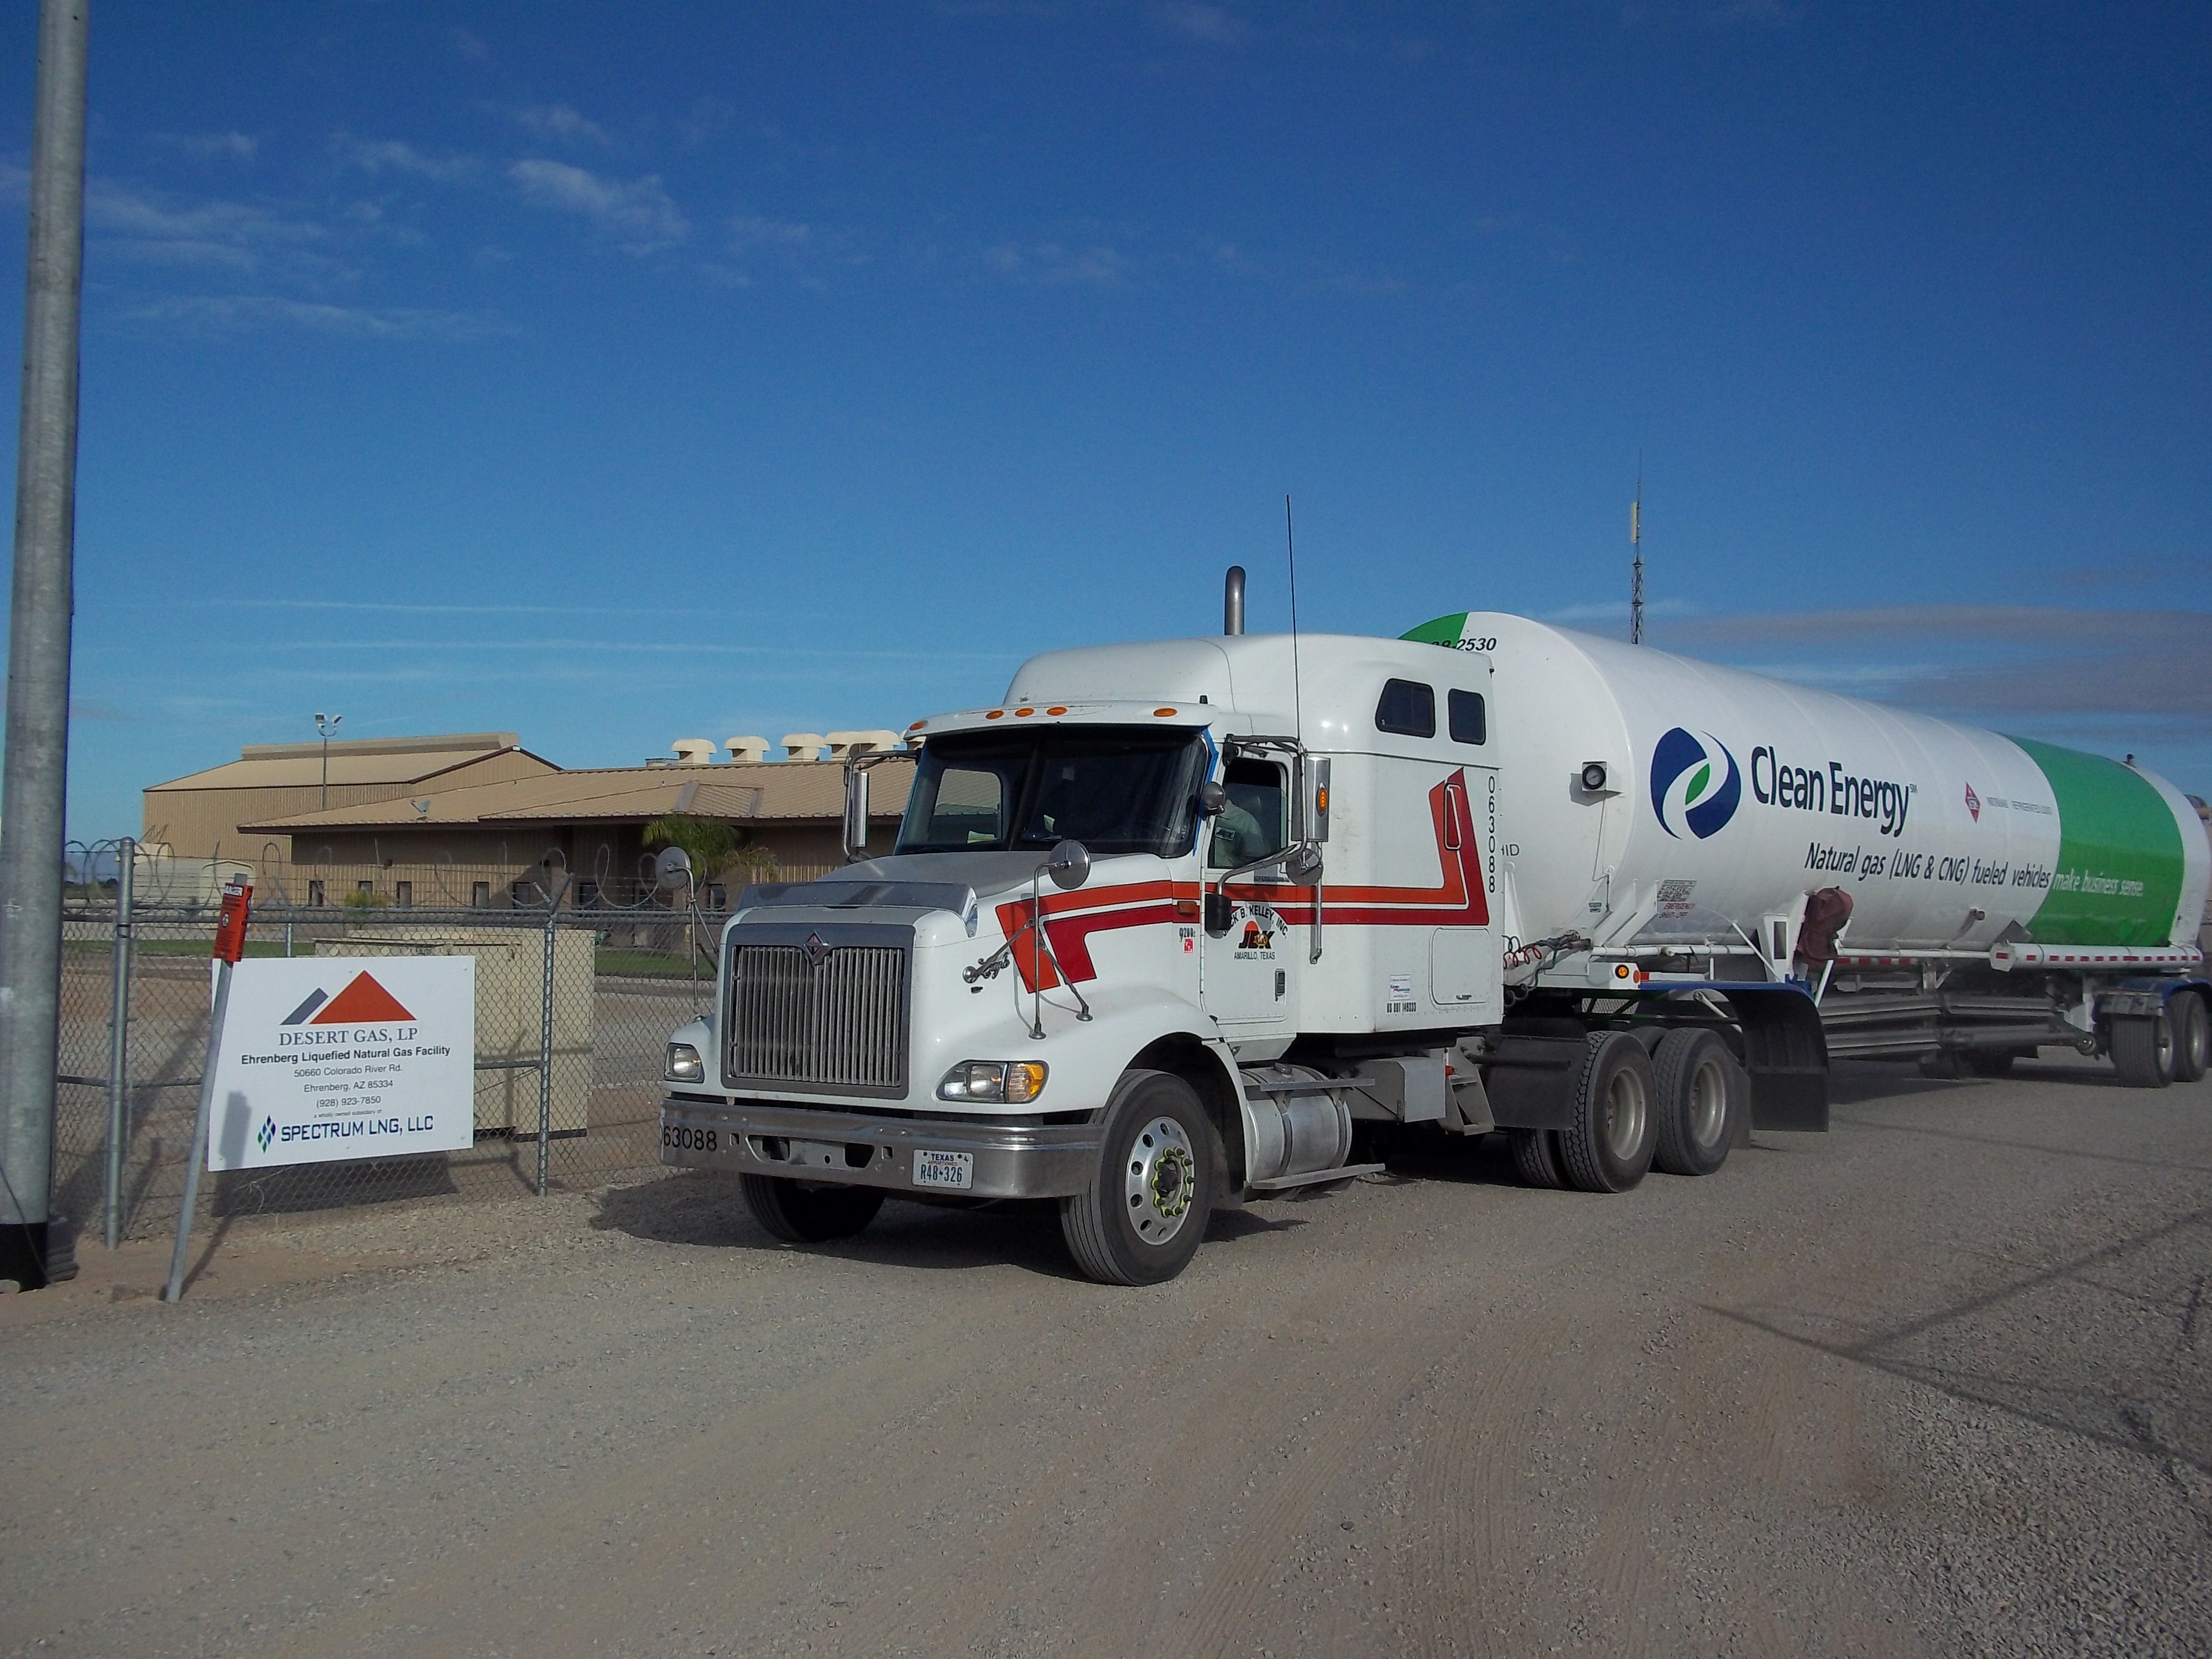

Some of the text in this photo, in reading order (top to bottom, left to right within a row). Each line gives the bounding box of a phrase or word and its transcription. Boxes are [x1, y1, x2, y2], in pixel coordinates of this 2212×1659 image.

[1751, 745, 1909, 838] Clean Energy
[1804, 842, 1861, 873] Natural
[1858, 854, 1886, 881] gas
[1889, 848, 1922, 880] (LNG
[1923, 855, 1934, 880] &
[1938, 855, 1970, 885] CNG)
[1971, 858, 2009, 885] fueled
[2011, 863, 2052, 888] vehicles
[2052, 868, 2081, 891] make
[1240, 907, 1248, 919] B.
[1249, 904, 1274, 925] KELLEY,
[1276, 917, 1288, 940] INC.
[1234, 951, 1276, 960] AMARILLO, TEXAS
[279, 1027, 418, 1046] DESERT GAS, LP
[241, 1045, 451, 1065] Ehrenberg Liquefied Natural Gas Facility
[294, 1064, 403, 1078] 50660 Colorado River Rd.
[304, 1079, 393, 1093] Ehrenberg, AZ 85334
[316, 1095, 381, 1109] (928) 923-7850
[281, 1115, 433, 1141] SPECTRUM LNG, LLC
[664, 1125, 718, 1151] 63088
